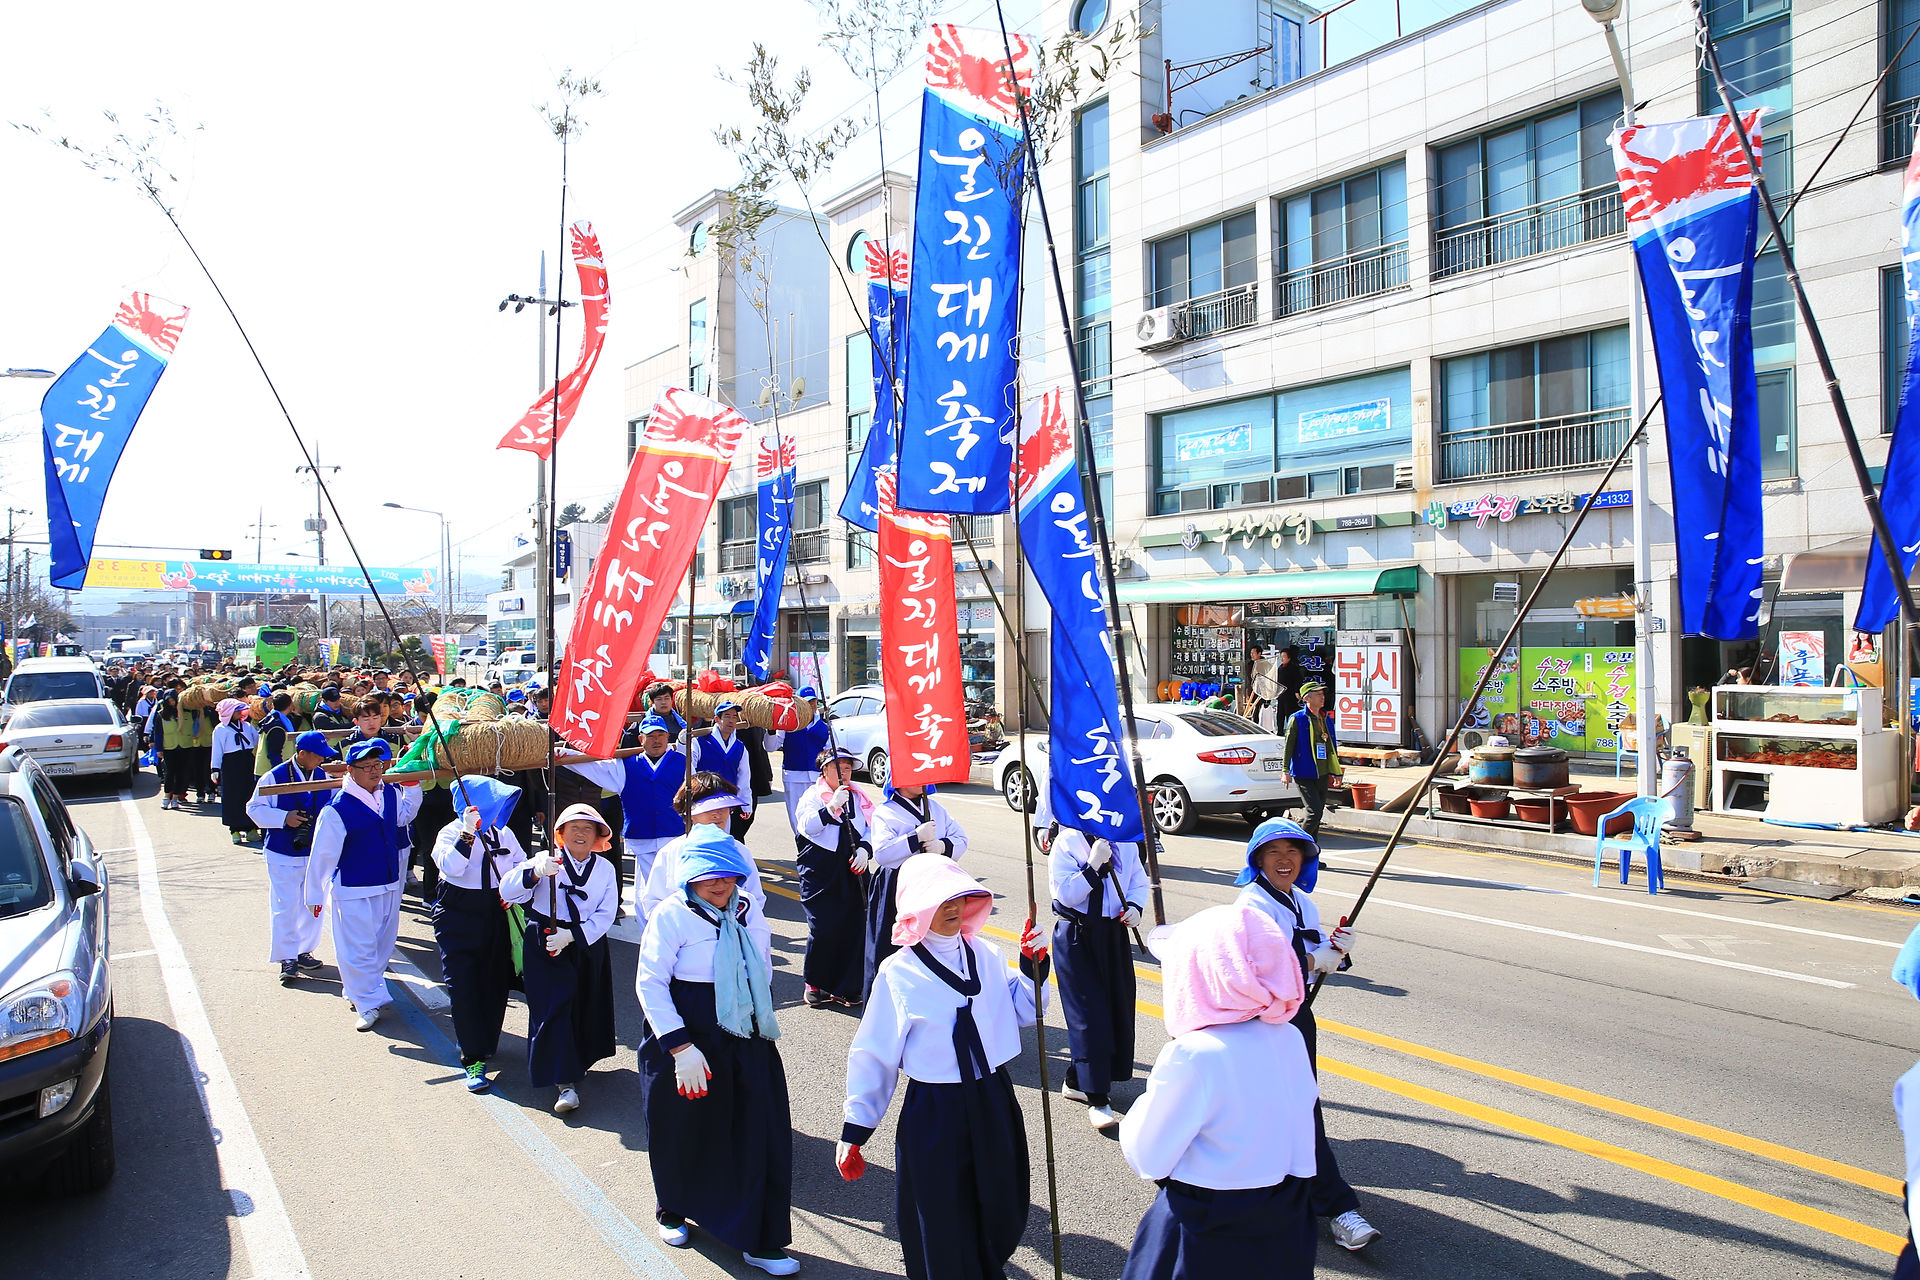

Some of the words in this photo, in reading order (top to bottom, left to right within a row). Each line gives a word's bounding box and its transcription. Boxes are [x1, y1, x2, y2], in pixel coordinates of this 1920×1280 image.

[1451, 499, 1476, 514] 후포
[1471, 494, 1519, 527] 수정
[1524, 490, 1575, 514] 소주방
[1585, 494, 1630, 505] 78-1332
[1537, 656, 1572, 676] 수정
[1604, 652, 1634, 663] 후포
[1338, 652, 1397, 689] 낚시
[1533, 677, 1575, 695] 소주방
[1339, 697, 1396, 731] 얼음
[1530, 701, 1578, 718] 바다장어
[1597, 738, 1617, 748] 788-
